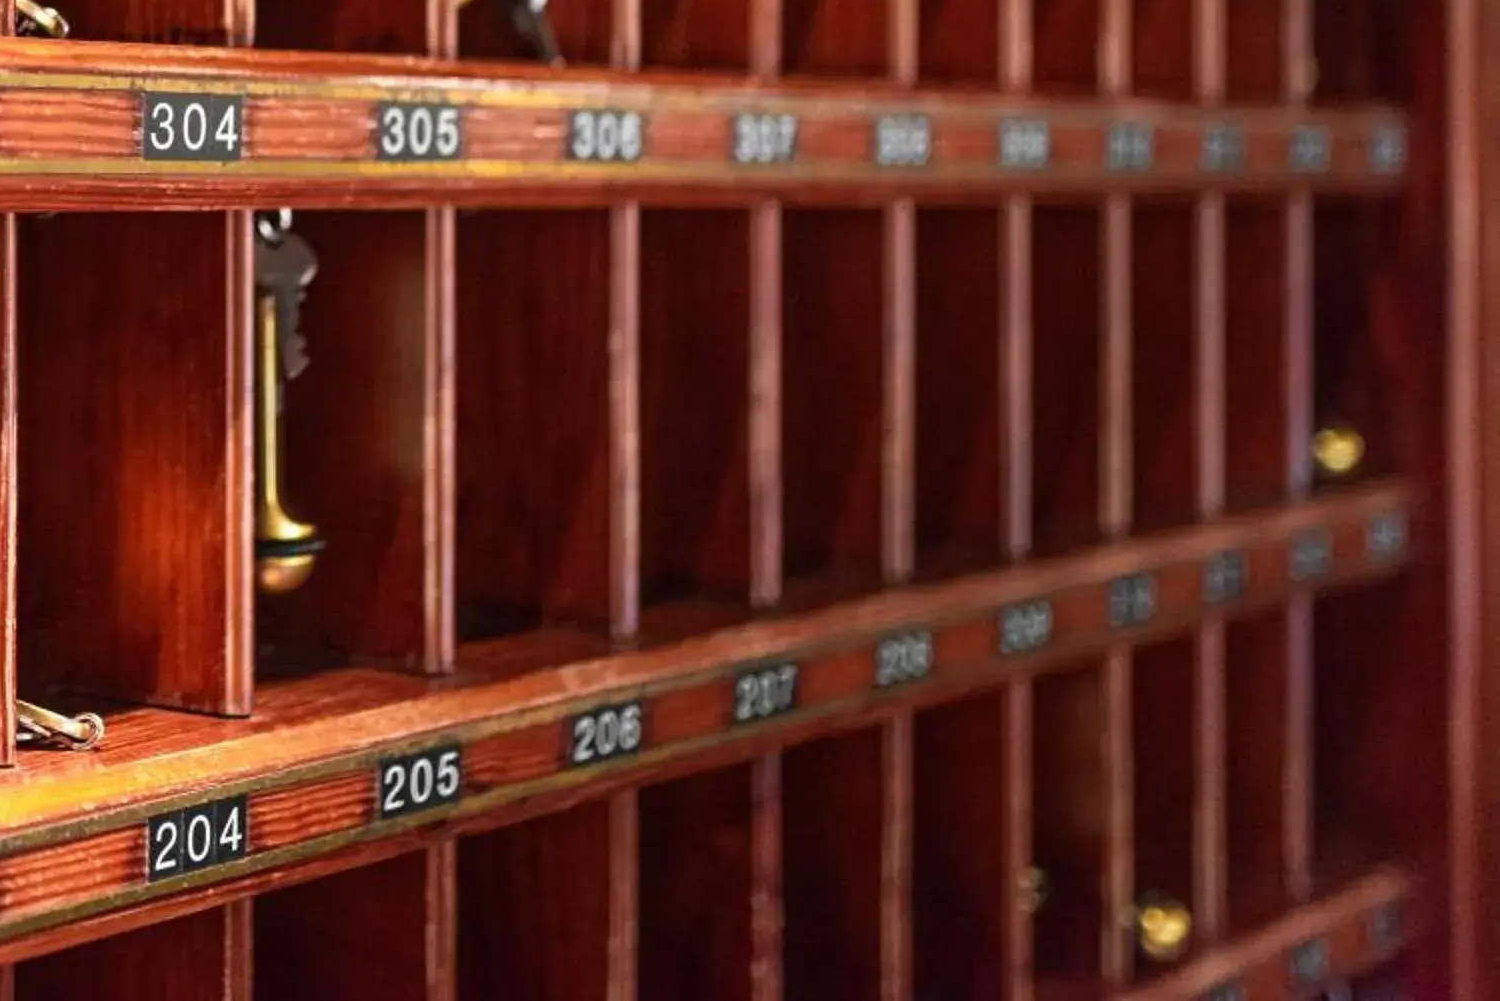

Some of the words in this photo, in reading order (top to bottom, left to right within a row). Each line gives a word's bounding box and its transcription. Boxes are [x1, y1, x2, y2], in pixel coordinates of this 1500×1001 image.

[150, 102, 238, 151] 304
[382, 108, 459, 155] 305
[573, 112, 641, 159] 306
[574, 704, 641, 762] 206
[384, 751, 459, 810] 205
[155, 806, 243, 872] 204
